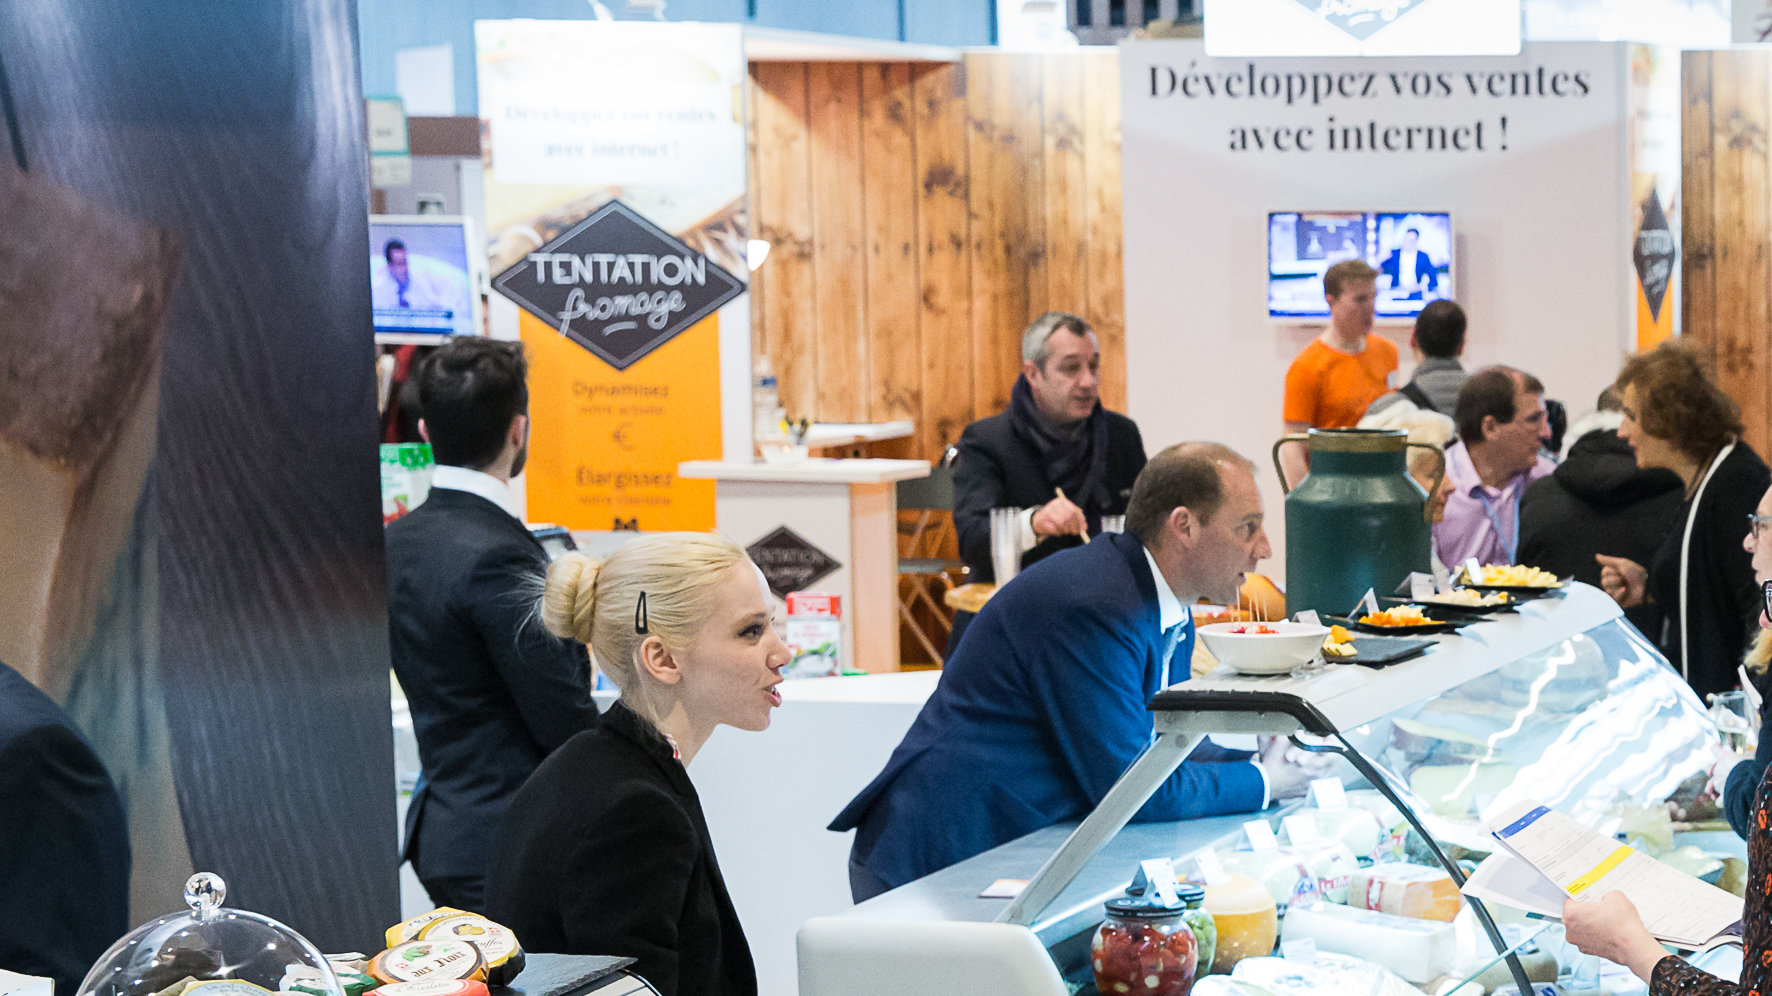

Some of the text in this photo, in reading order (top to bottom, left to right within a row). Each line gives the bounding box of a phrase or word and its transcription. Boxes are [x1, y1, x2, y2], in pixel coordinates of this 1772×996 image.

[1148, 61, 1591, 105] Développez vos ventes
[1228, 116, 1510, 152] avec internet !
[528, 253, 706, 286] TENTATION
[555, 287, 687, 338] fromage
[572, 380, 669, 400] Dynamisez
